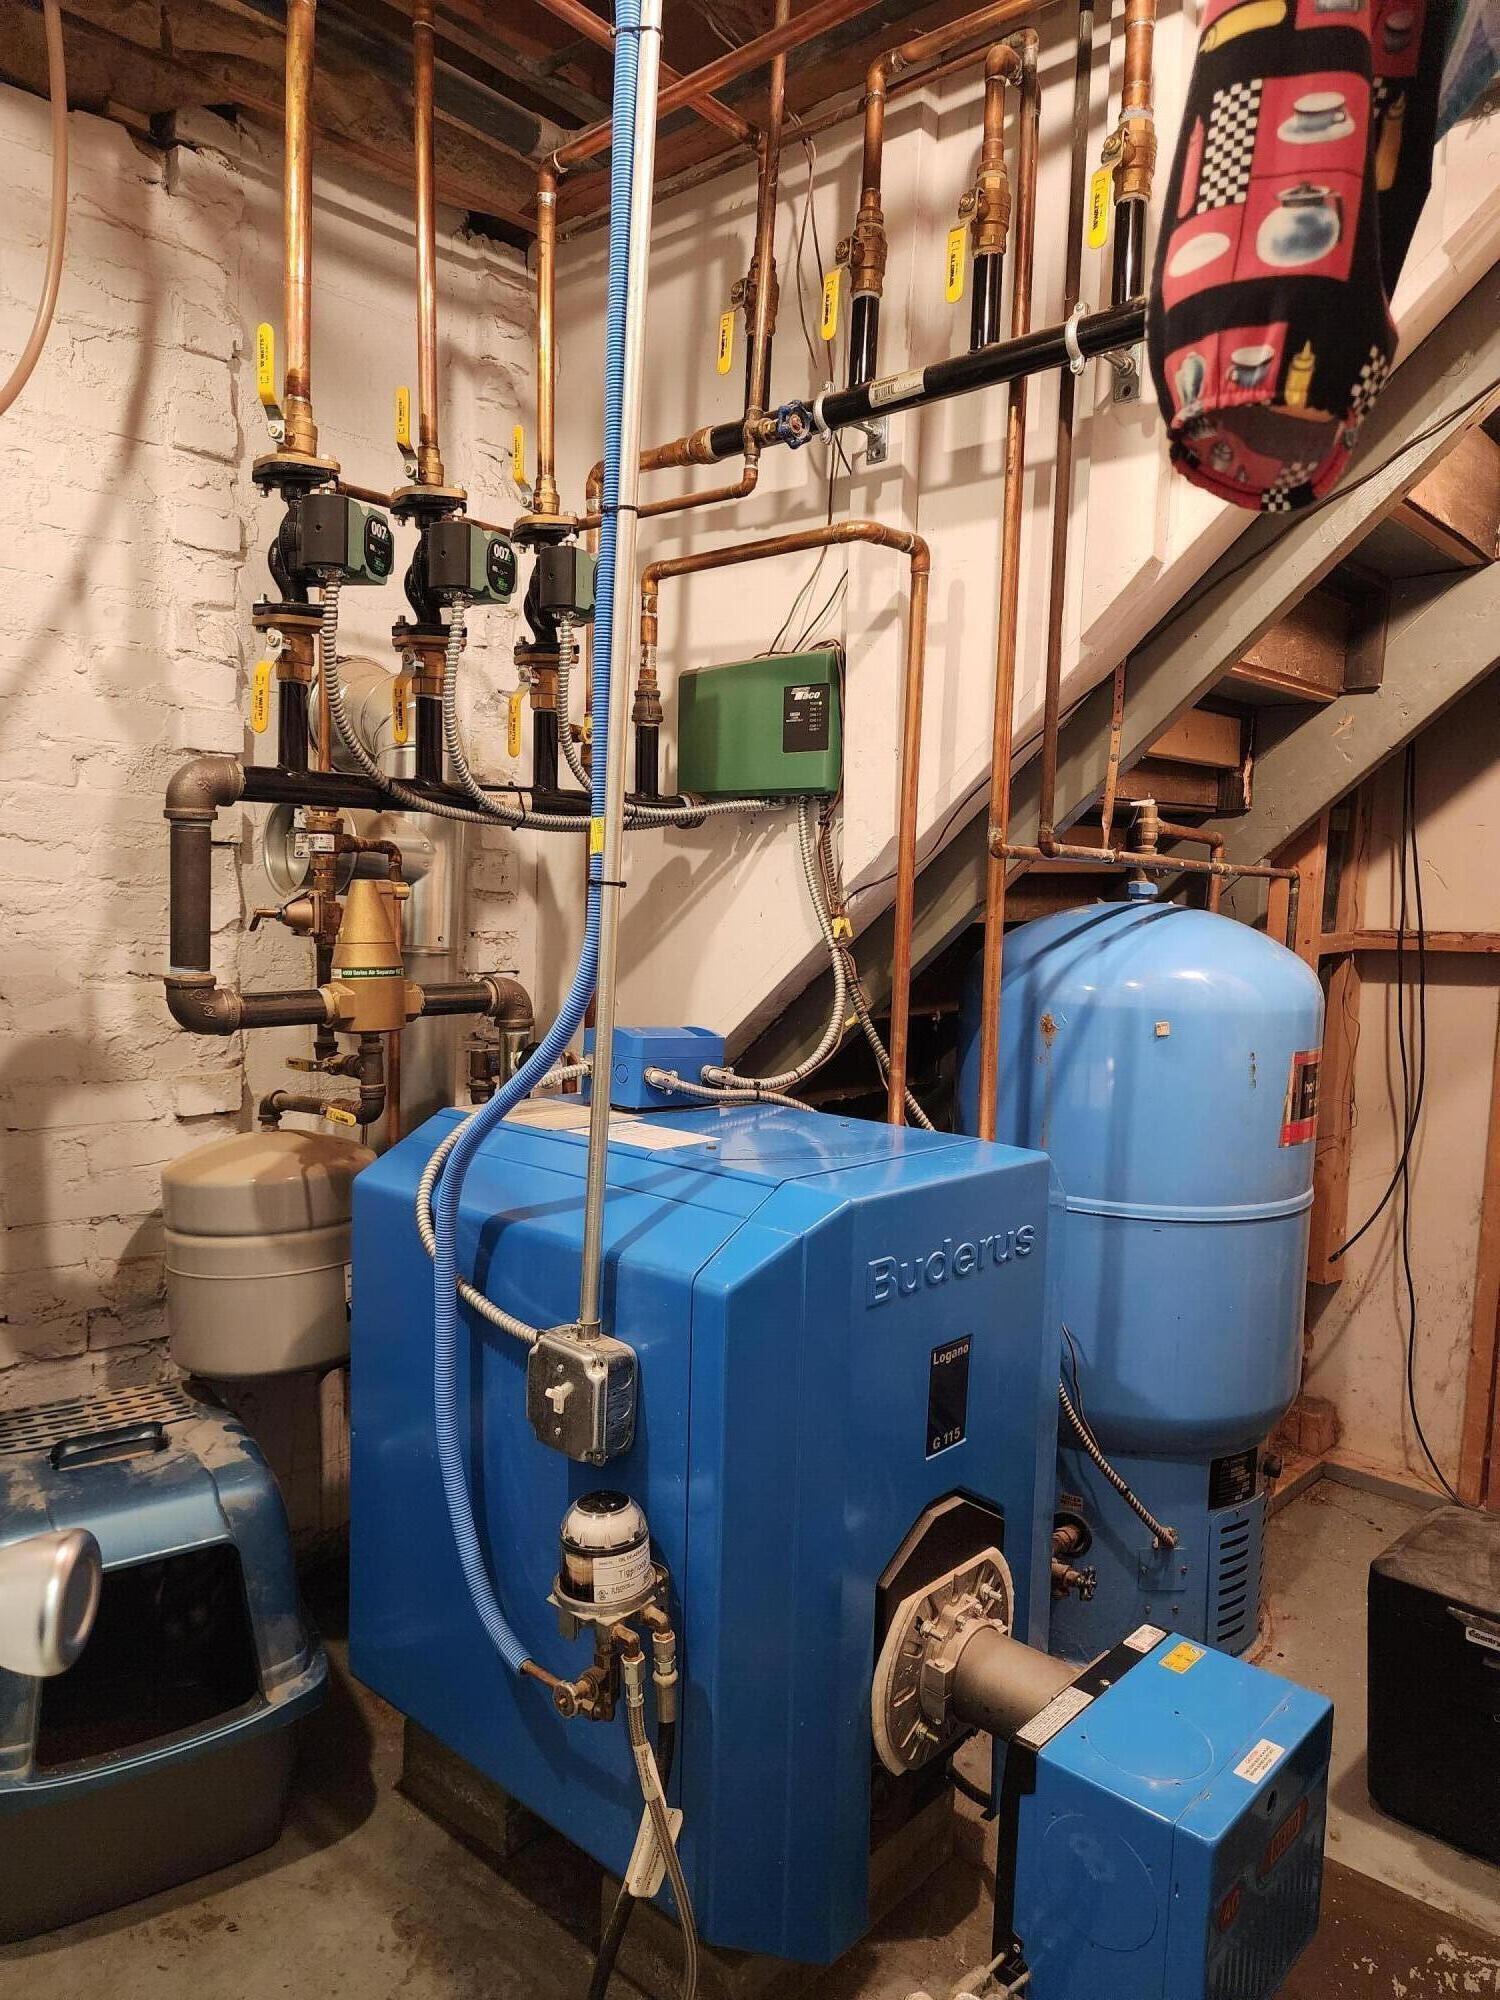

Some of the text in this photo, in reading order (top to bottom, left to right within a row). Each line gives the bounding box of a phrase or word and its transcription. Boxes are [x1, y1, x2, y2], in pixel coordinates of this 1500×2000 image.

[867, 1224, 1036, 1308] Buderus
[932, 1344, 969, 1365] Logano
[932, 1427, 961, 1450] G 115
